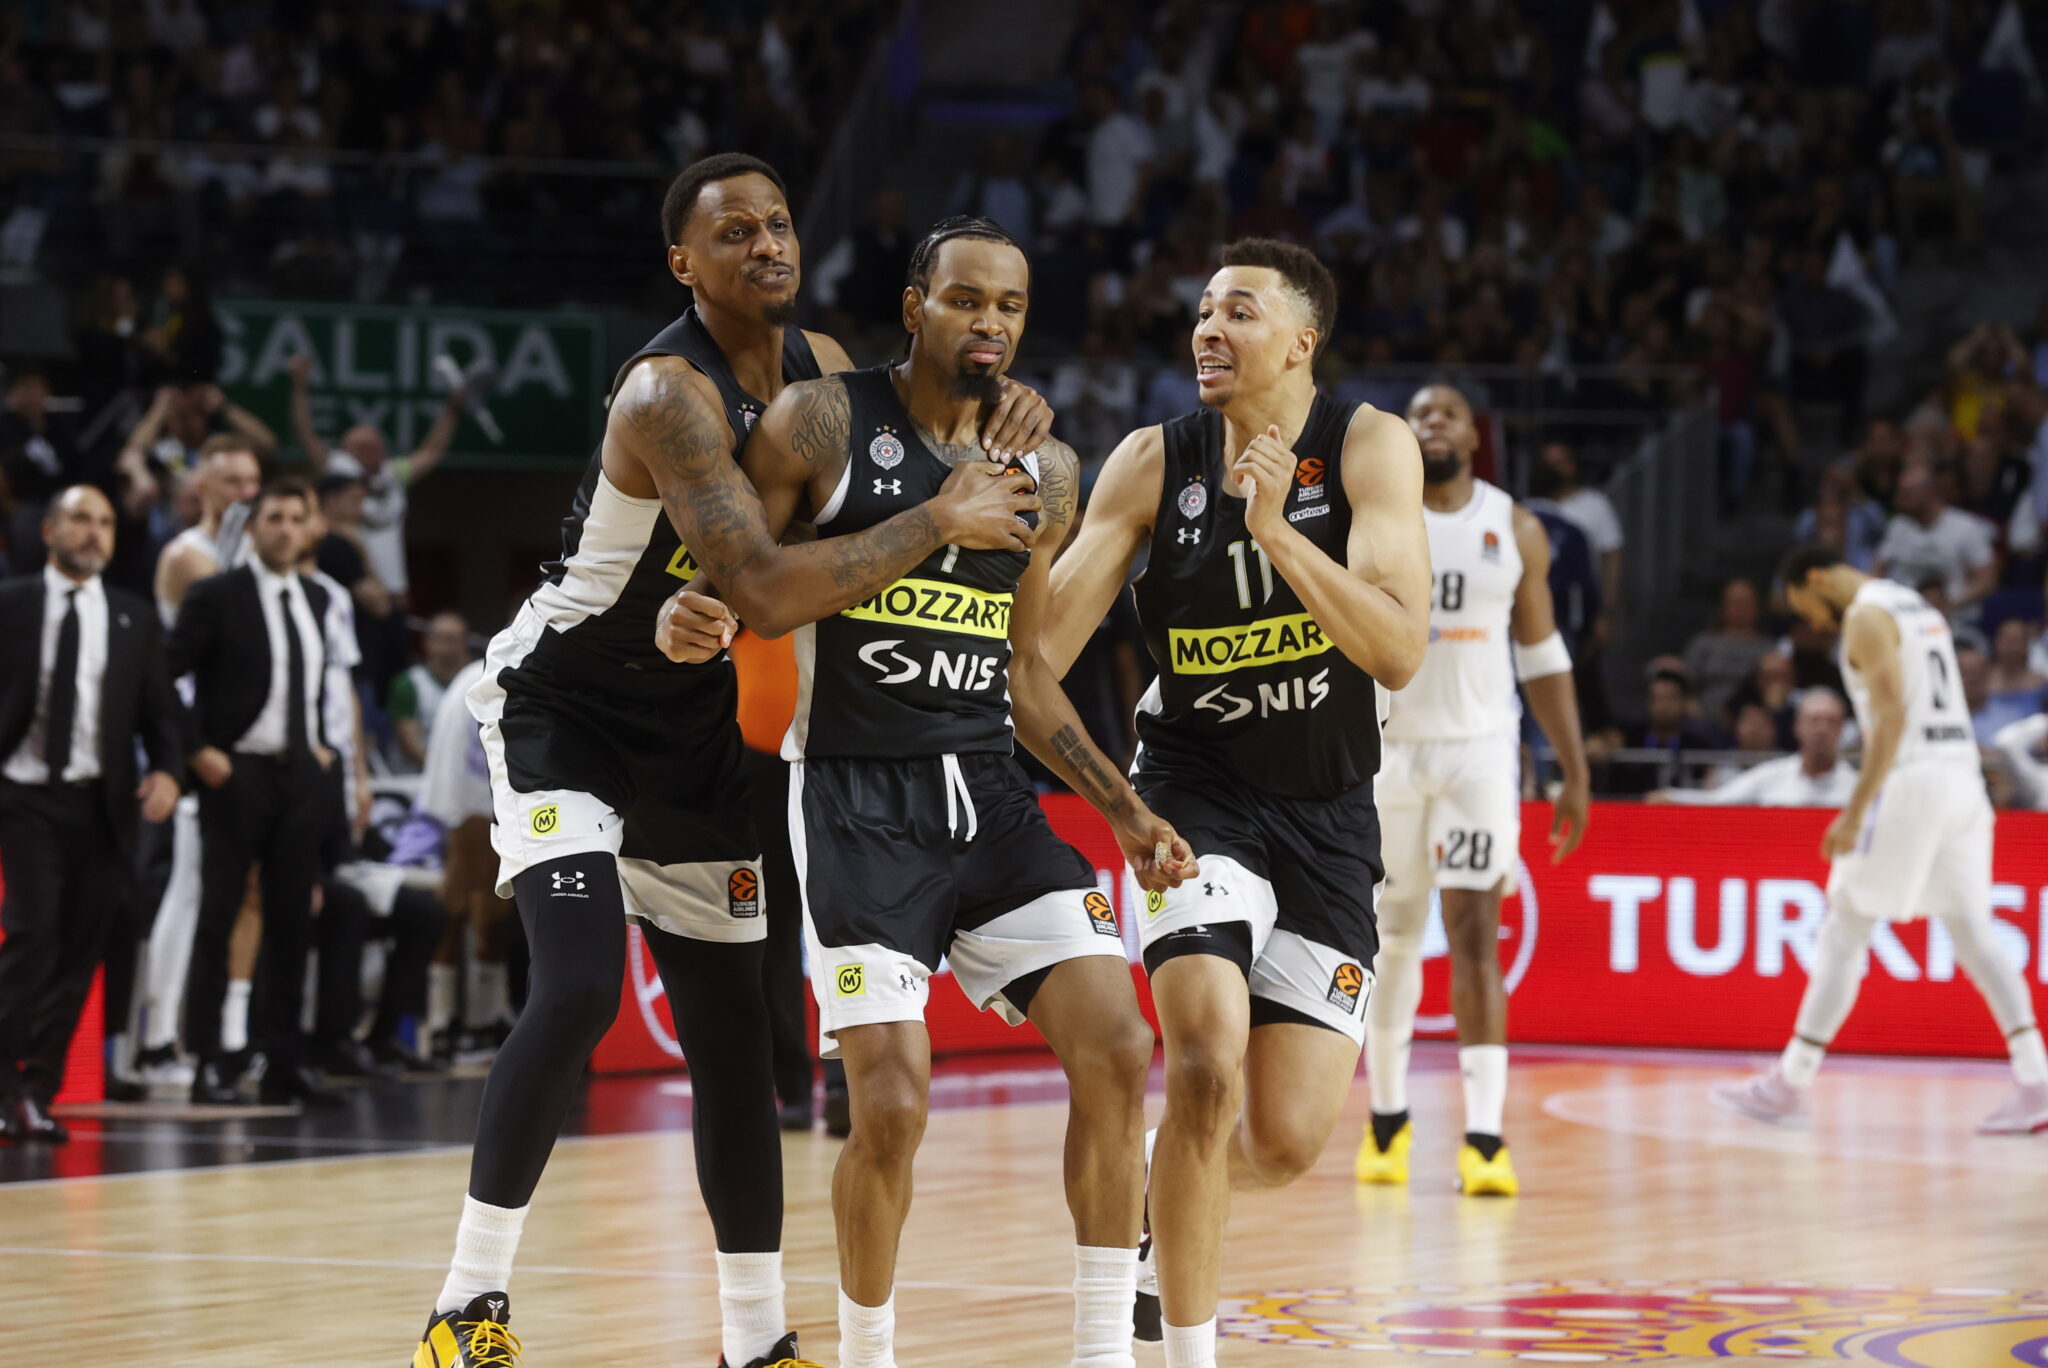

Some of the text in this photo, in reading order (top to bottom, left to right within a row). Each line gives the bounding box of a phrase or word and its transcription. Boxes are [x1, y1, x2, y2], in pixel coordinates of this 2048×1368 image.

[213, 310, 575, 398] SALIDA
[1228, 541, 1274, 609] 11
[1431, 571, 1464, 611] 8
[929, 650, 999, 691] NIS
[1258, 667, 1330, 719] NIS
[1448, 830, 1492, 871] 28
